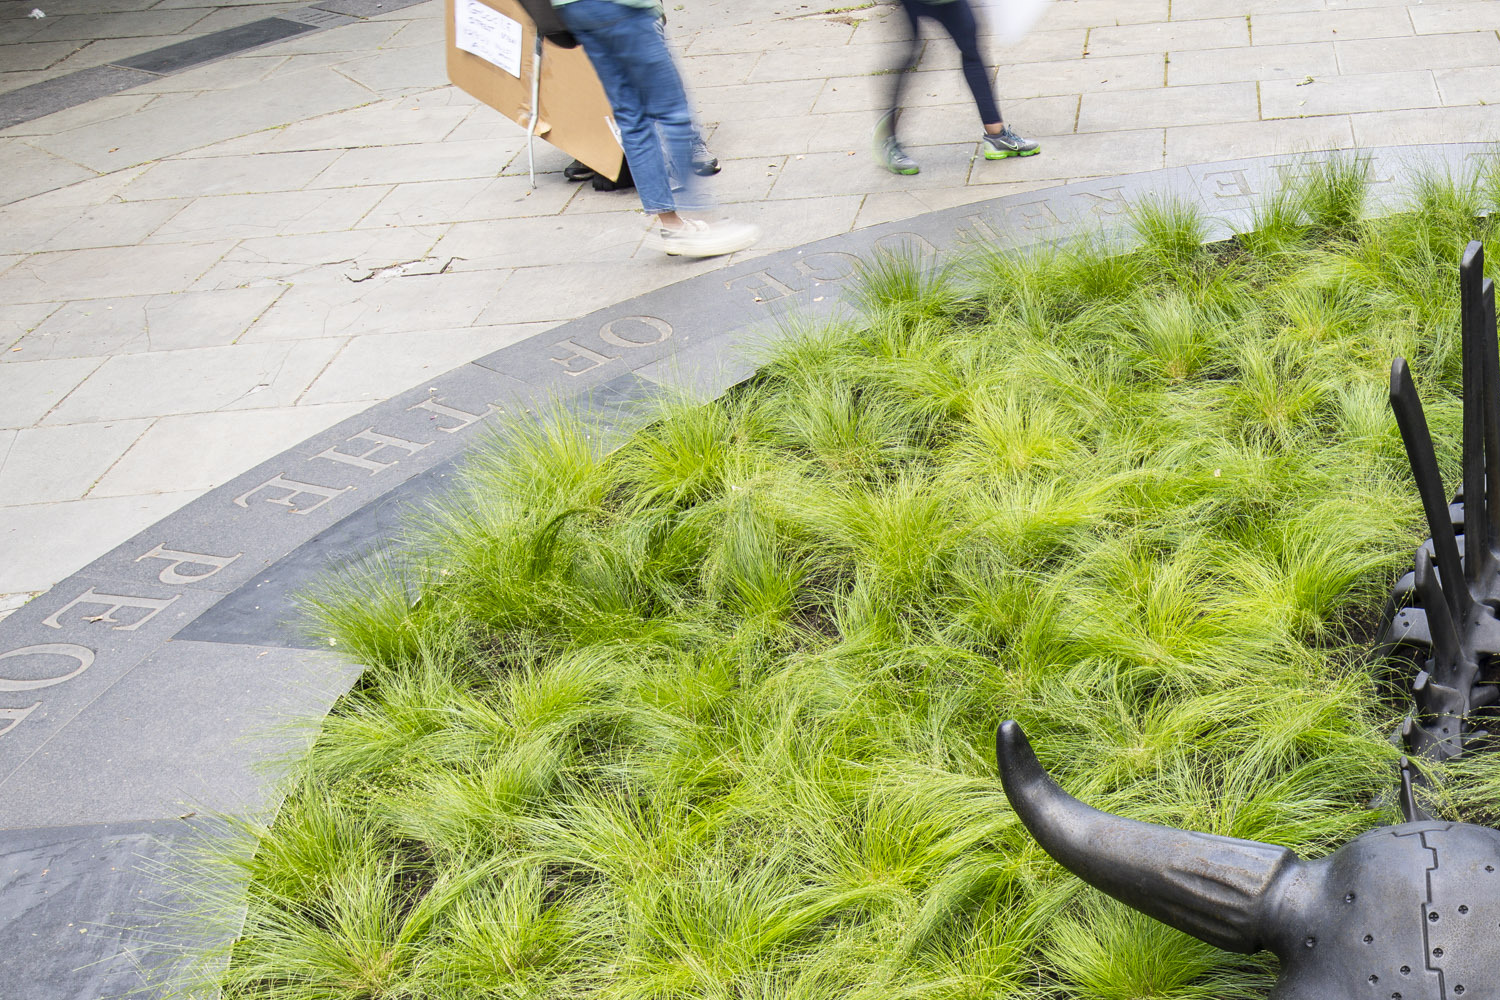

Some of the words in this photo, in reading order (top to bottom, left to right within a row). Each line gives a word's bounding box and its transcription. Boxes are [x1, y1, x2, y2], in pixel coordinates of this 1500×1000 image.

[724, 184, 1137, 305] REFUGE
[549, 314, 674, 377] OF
[232, 395, 504, 516] THE
